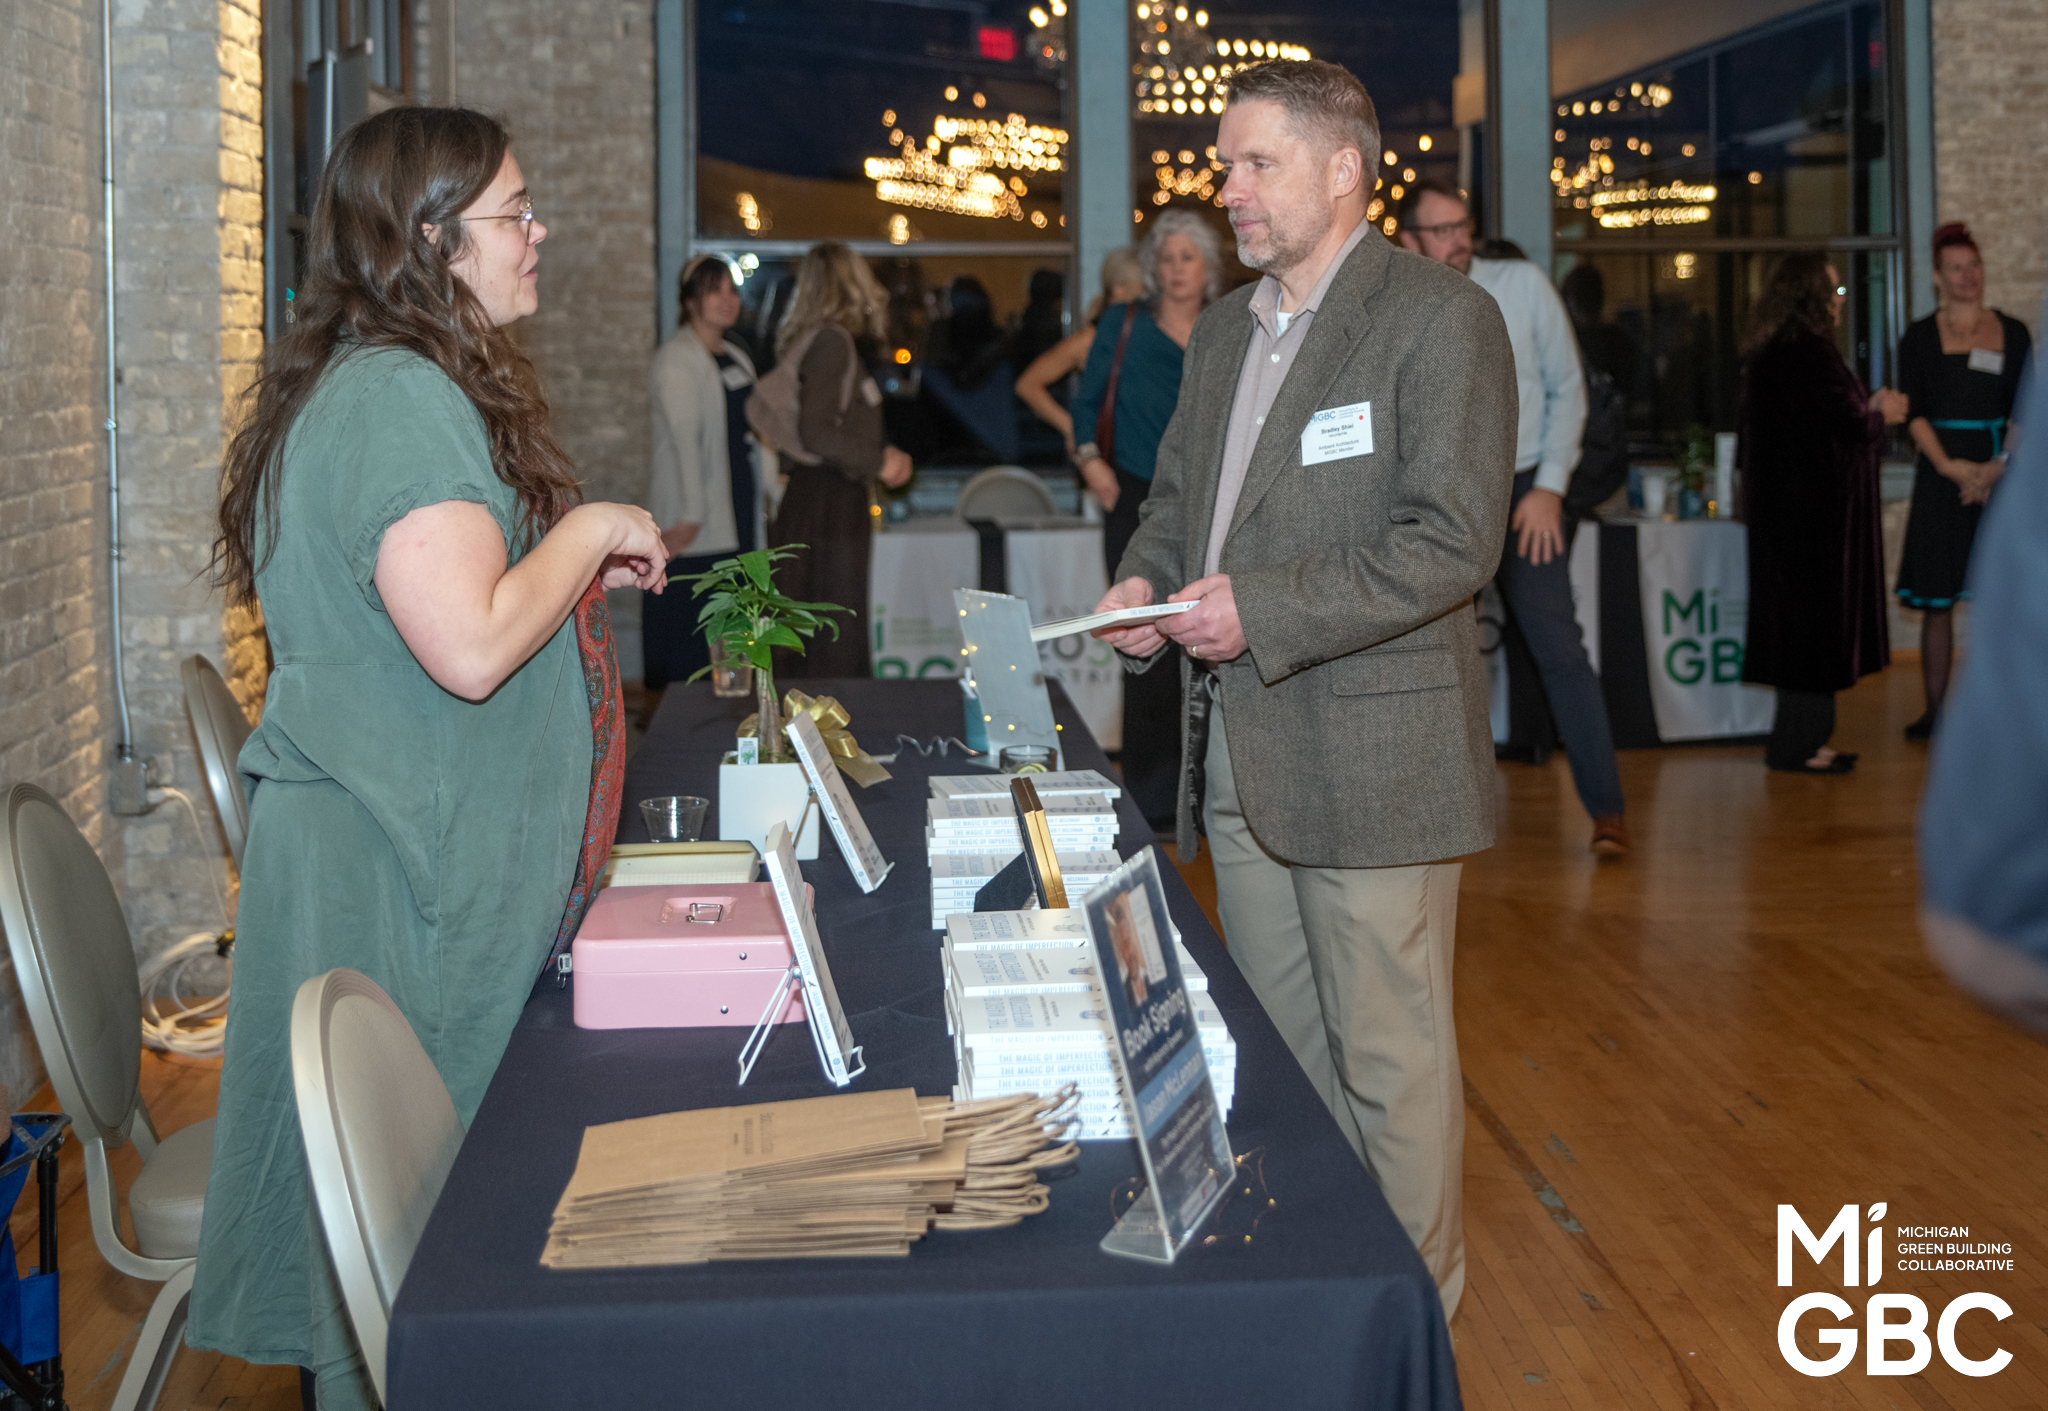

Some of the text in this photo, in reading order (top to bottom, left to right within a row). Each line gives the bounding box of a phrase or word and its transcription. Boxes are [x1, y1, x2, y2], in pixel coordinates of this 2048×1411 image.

[1321, 426, 1340, 434] Bradley
[1663, 588, 1719, 636] Mi
[1665, 638, 1744, 685] GB
[774, 876, 785, 889] THE
[780, 890, 793, 914] MAGIC
[787, 914, 796, 924] OF
[790, 926, 812, 976] IMPERFECTION
[1026, 941, 1074, 949] IMPERFECTION
[1003, 987, 1028, 995] MAGIC
[1041, 984, 1092, 993] IMPERFECTION
[1123, 1018, 1154, 1059] Book
[1150, 987, 1187, 1033] Signing
[991, 1033, 1103, 1044] THE MAGIC OF IMPERFECTION
[999, 1050, 1110, 1062] THE MAGIC OF IMPERFECTION
[1001, 1062, 1112, 1075] THE MAGIC OF IMPERFECTION
[998, 1079, 1012, 1088] THE
[1015, 1078, 1040, 1087] MAGIC
[1043, 1077, 1052, 1086] OF
